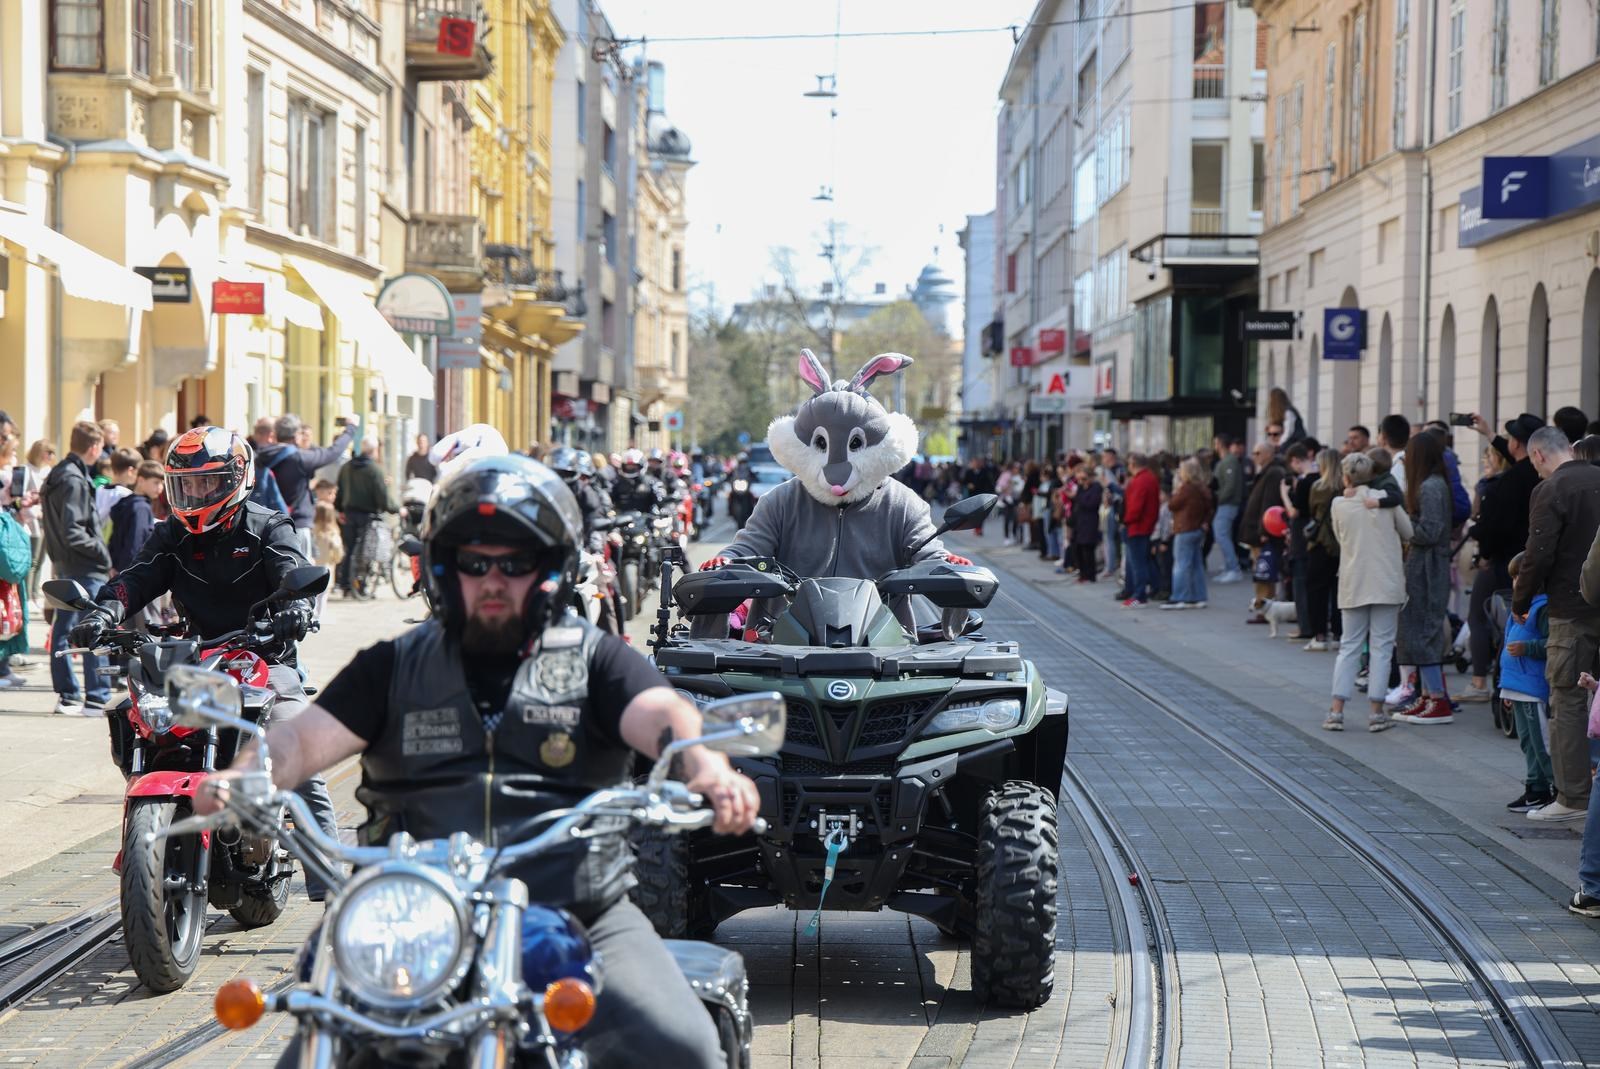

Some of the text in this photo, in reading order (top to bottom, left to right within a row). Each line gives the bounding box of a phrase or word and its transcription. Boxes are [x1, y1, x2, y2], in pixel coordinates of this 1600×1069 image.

[445, 21, 469, 50] S
[1500, 170, 1528, 203] F
[1245, 320, 1290, 331] telemach
[1047, 371, 1071, 394] A1
